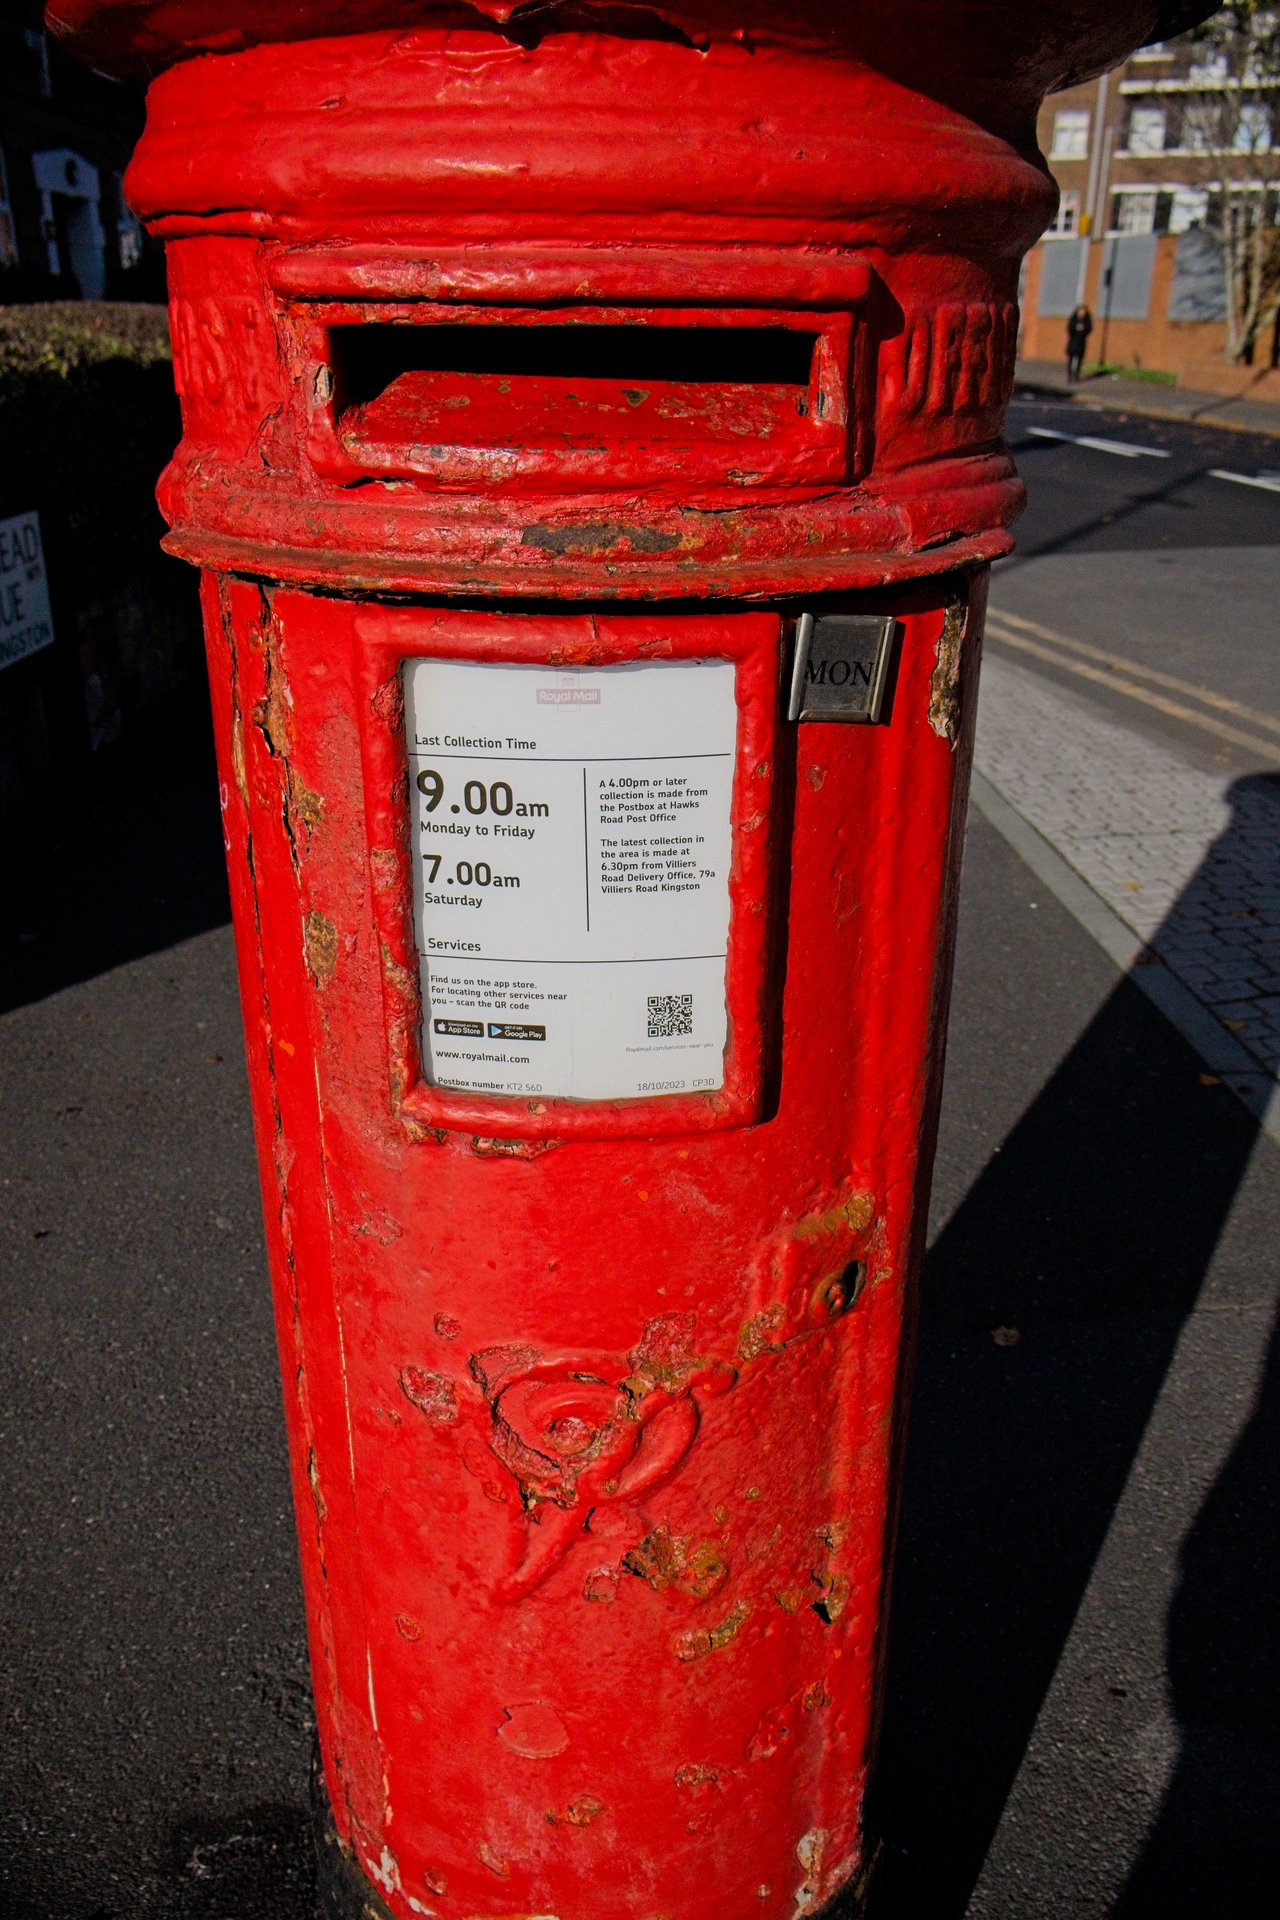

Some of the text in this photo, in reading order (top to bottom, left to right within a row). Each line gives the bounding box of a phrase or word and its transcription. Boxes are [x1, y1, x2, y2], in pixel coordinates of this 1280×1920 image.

[804, 660, 875, 686] MON
[539, 690, 598, 703] Royal Mail
[415, 734, 537, 750] Last Collection Time
[599, 778, 688, 789] A 4.00pm or later
[417, 769, 549, 817] 9.00am
[600, 788, 708, 800] collection is made from
[600, 800, 700, 812] the Postbox at Hawks
[600, 813, 677, 824] Road Post Office
[420, 821, 536, 840] Monday to Friday
[600, 834, 705, 847] The latest collection in
[601, 850, 616, 859] the
[642, 849, 650, 857] is
[652, 848, 678, 857] made
[680, 847, 690, 856] at
[422, 854, 521, 888] 7.00am
[601, 860, 697, 872] 6.30pm from Villiers
[601, 870, 716, 883] Road Delivery Office, 79a
[601, 882, 700, 894] Villiers Road Kingston
[425, 892, 483, 909] Saturday
[428, 937, 482, 952] Services
[430, 975, 538, 989] Find us on the app store.
[431, 986, 445, 994] For
[447, 986, 481, 998] locating
[483, 989, 507, 998] other
[509, 991, 545, 1000] services
[432, 997, 447, 1005] you
[456, 999, 476, 1007] scan
[478, 999, 492, 1008] the
[494, 1000, 508, 1009] QR
[509, 1002, 530, 1010] code
[462, 1027, 481, 1035] Store
[504, 1029, 543, 1040] Google Play
[436, 1050, 530, 1064] www.royalmail.com
[437, 1076, 543, 1092] Postbox number KT2 56D
[636, 1078, 715, 1092] 18/10/2023 CP3D
